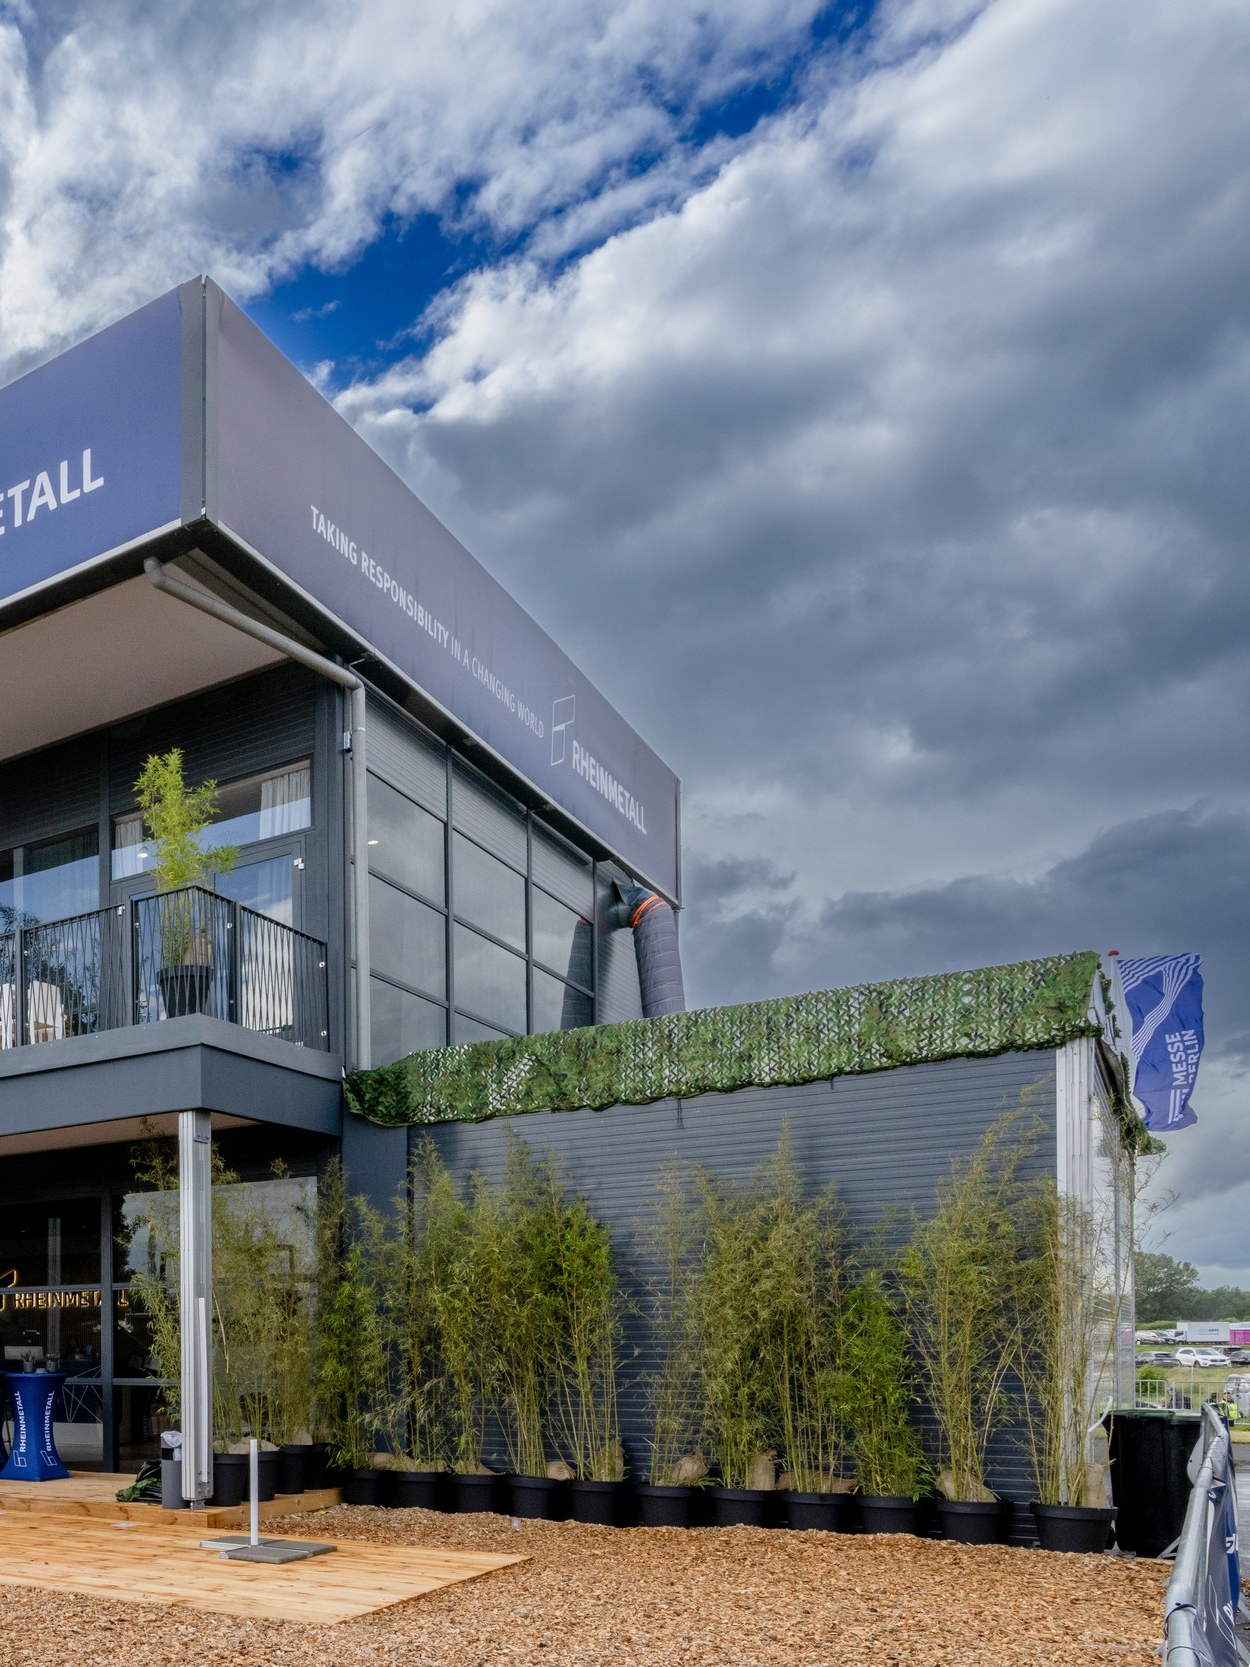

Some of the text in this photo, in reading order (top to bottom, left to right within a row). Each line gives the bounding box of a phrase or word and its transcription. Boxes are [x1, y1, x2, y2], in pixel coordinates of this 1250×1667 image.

[310, 504, 545, 739] TAKING RESPONSIBILITY IN A CHANGING WORLD
[572, 739, 647, 836] RHEINMETALL
[1165, 1032, 1188, 1086] MESSE
[15, 1289, 129, 1309] RHEINMETL
[14, 1390, 27, 1453] RHEINMETALL
[44, 1390, 55, 1452] RHEINMETALL
